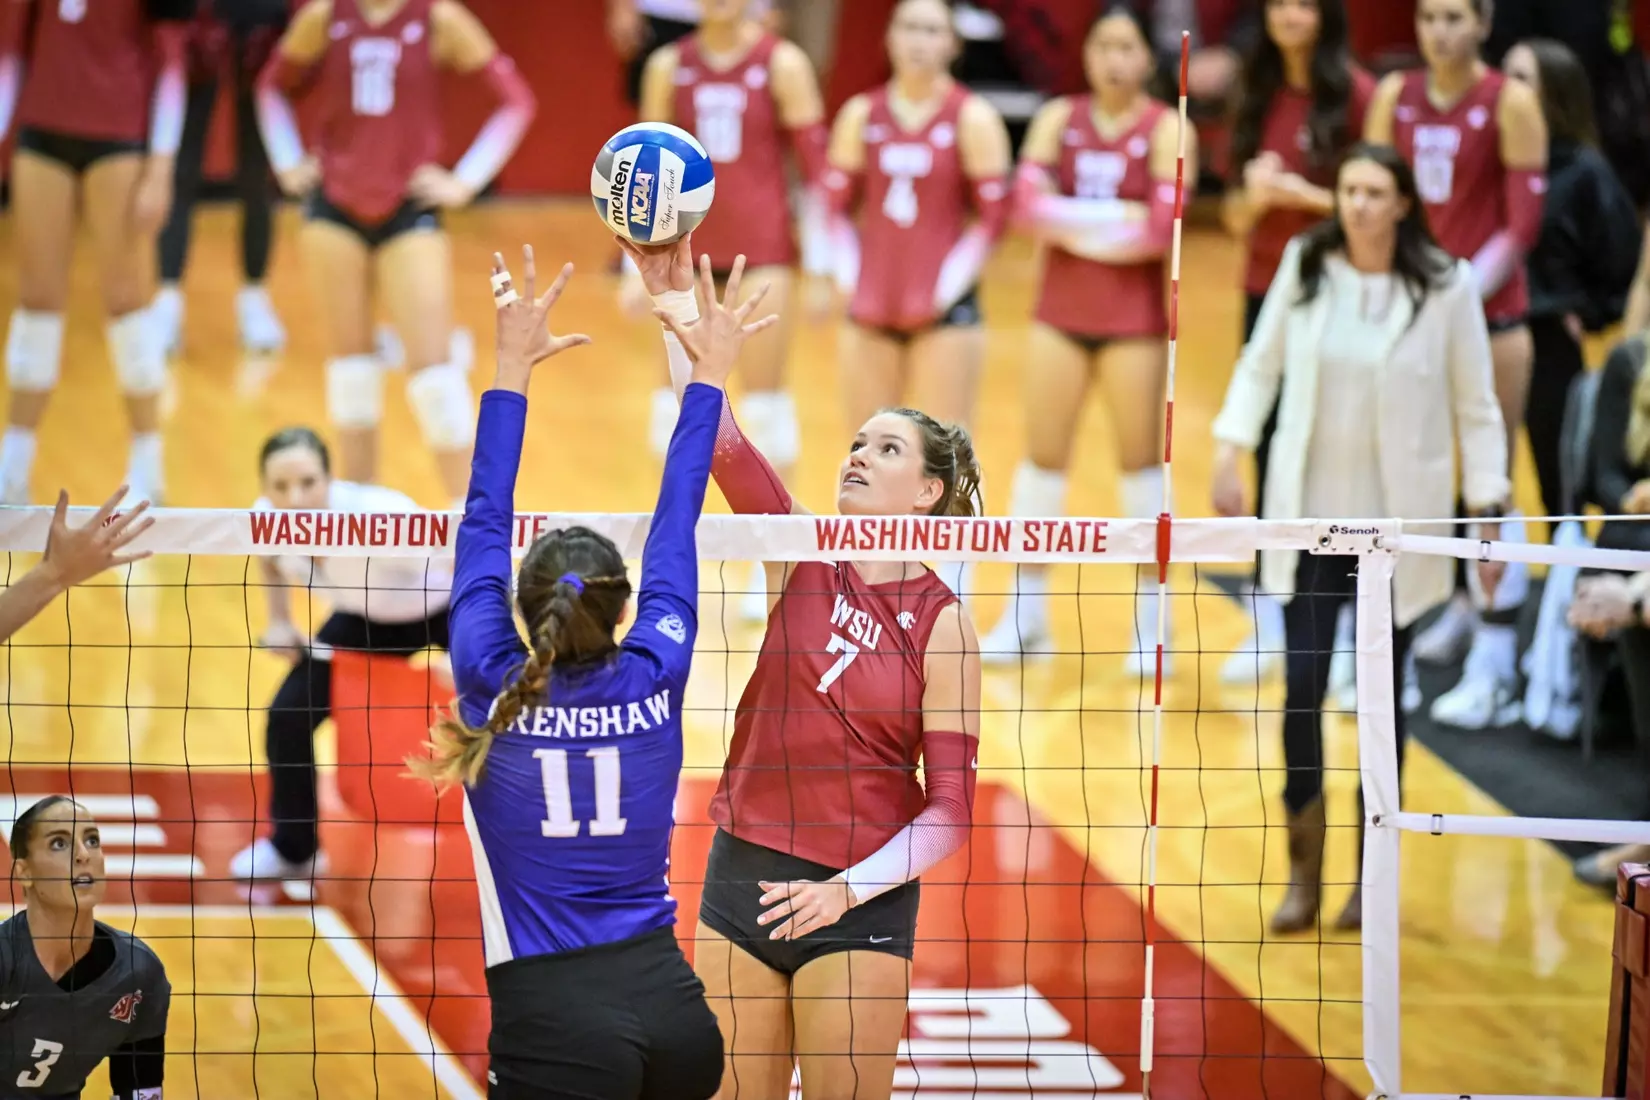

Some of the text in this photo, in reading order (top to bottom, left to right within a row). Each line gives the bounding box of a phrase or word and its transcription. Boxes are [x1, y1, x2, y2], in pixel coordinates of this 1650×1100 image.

[611, 160, 631, 226] molten
[630, 172, 653, 226] NCAA
[658, 168, 675, 231] Super Touch
[250, 511, 449, 547] WASHINGTON
[815, 517, 1109, 553] WASHINGTON STATE
[1340, 526, 1379, 535] Senoh
[830, 593, 882, 650] WSU
[816, 632, 860, 694] 7
[532, 746, 628, 838] 11
[16, 1037, 64, 1088] 3
